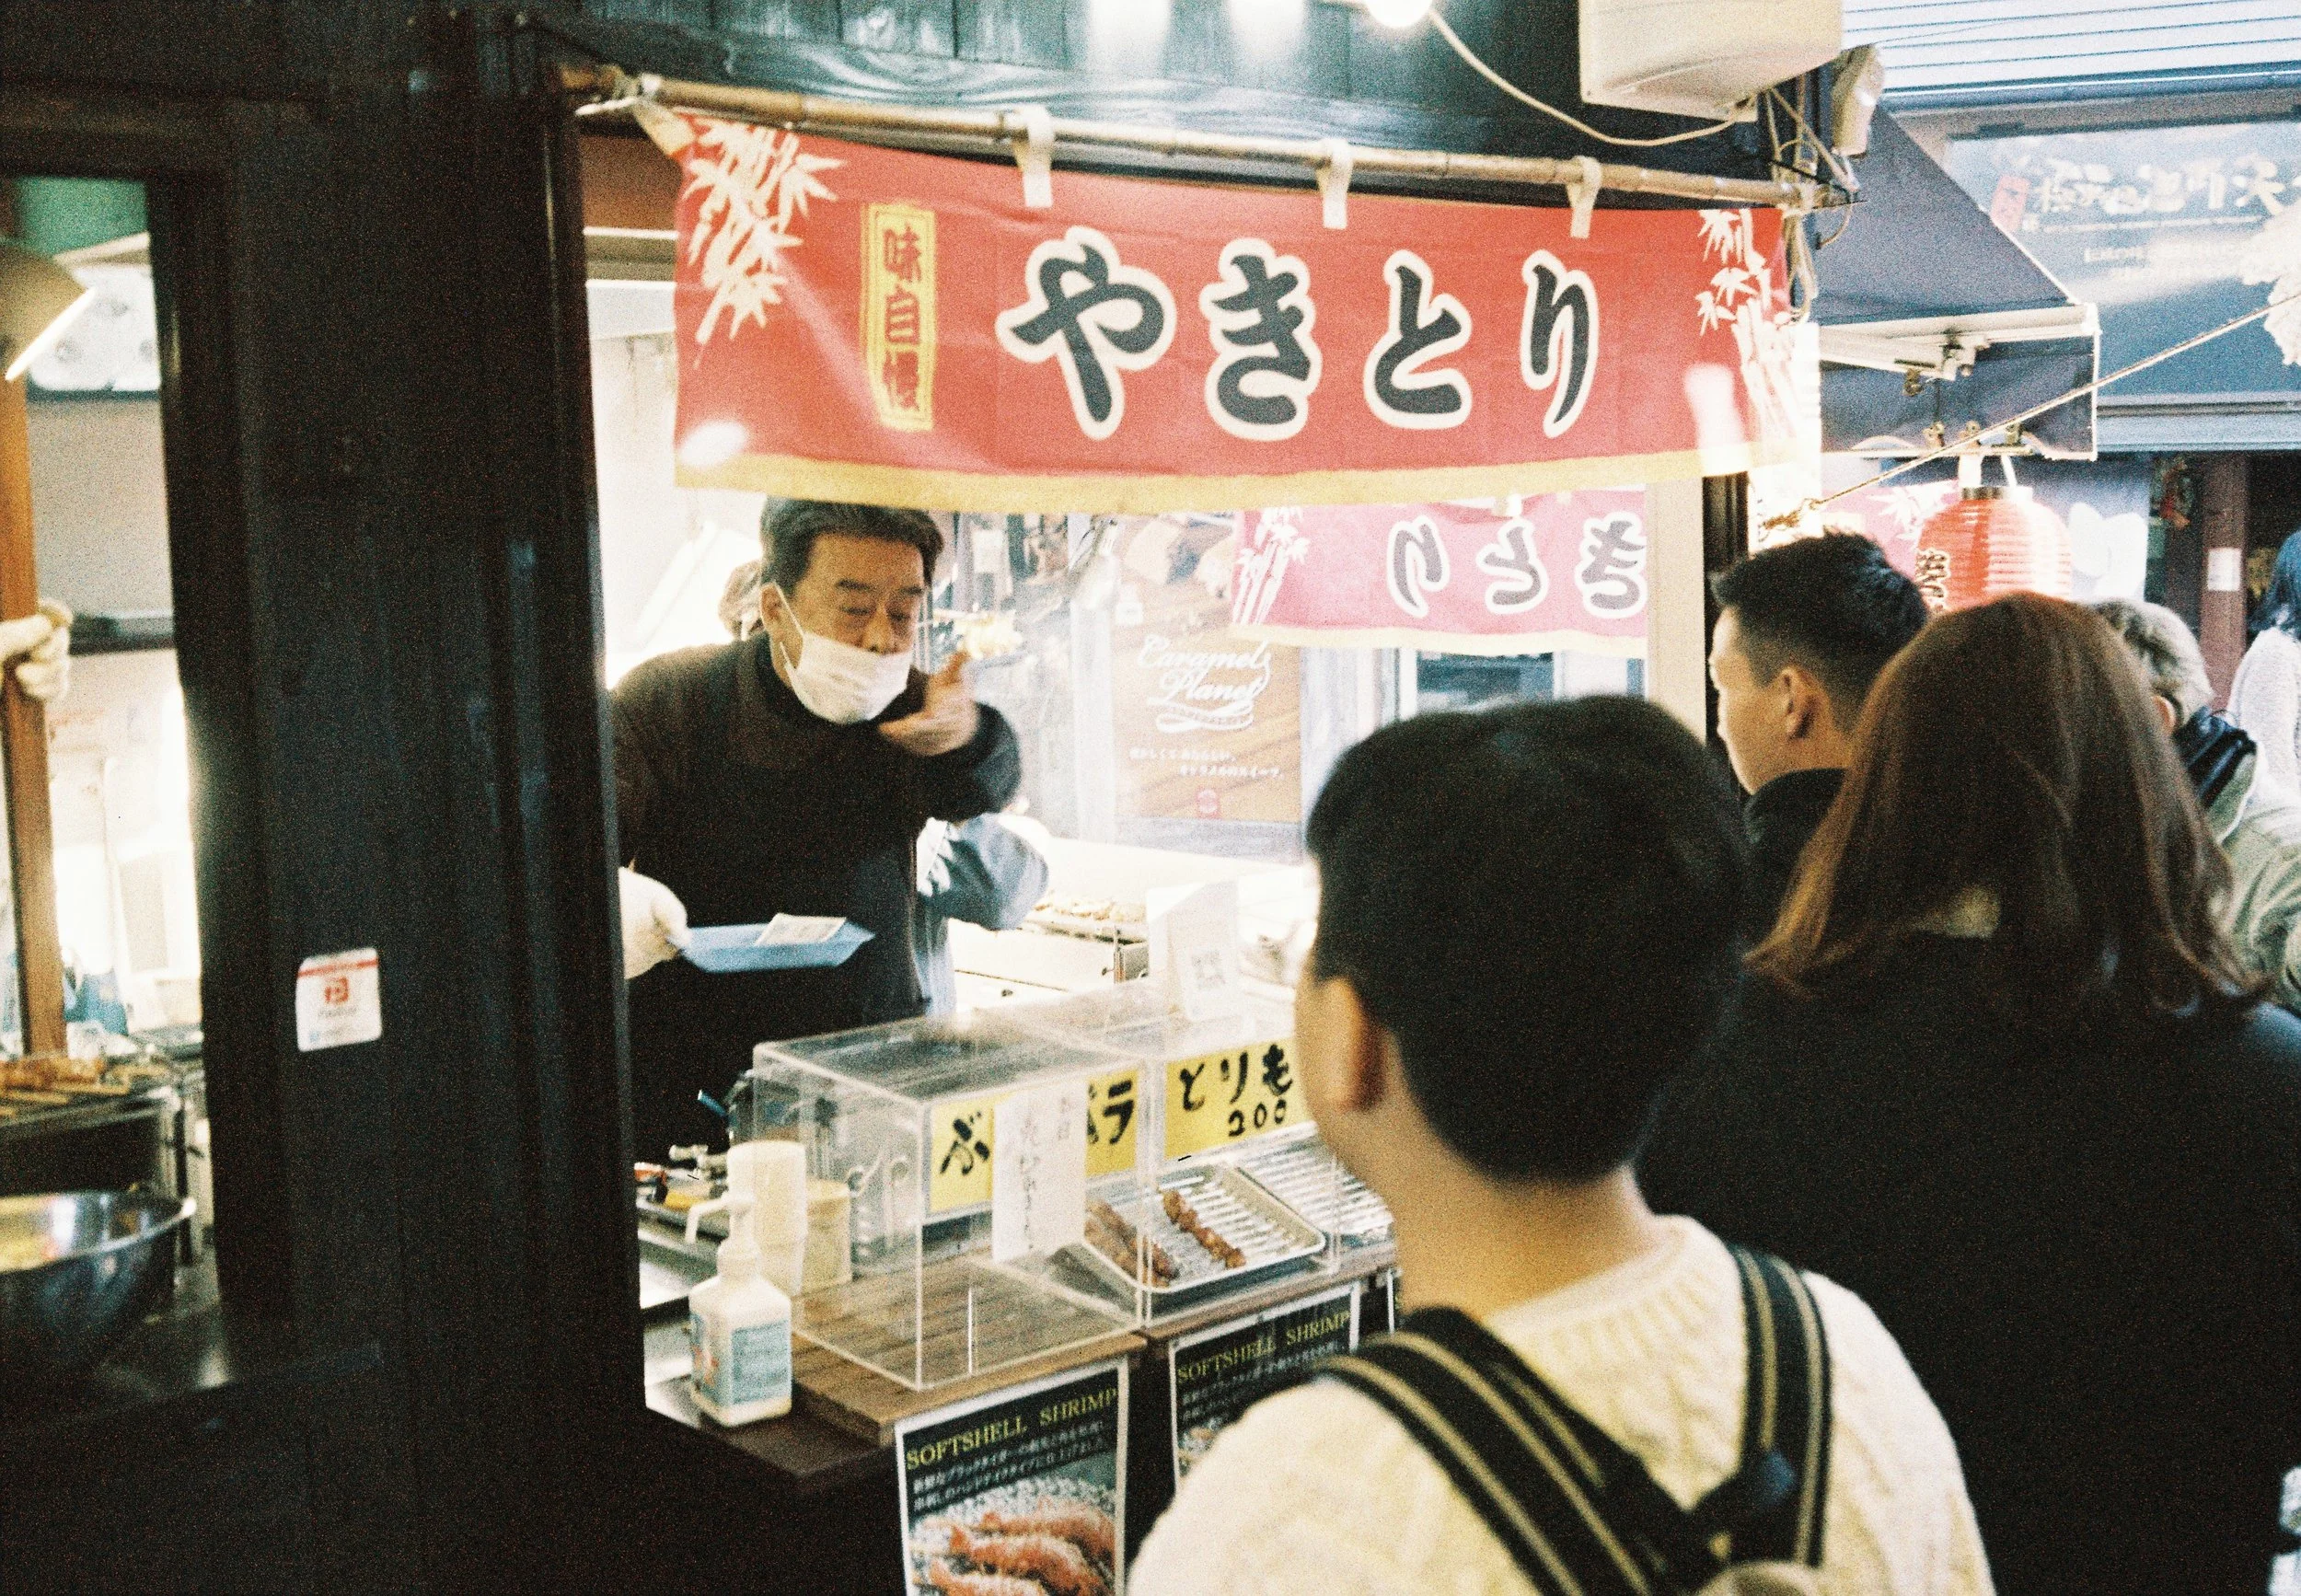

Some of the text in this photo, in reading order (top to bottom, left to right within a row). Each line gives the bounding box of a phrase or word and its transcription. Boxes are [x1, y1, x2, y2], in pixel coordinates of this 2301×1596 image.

[882, 224, 922, 412] 味自慢
[996, 226, 1598, 440] やきとり
[1137, 633, 1271, 672] Caramel
[1227, 1098, 1288, 1138] 200
[1176, 1335, 1278, 1385] SOFTSHELL
[1285, 1311, 1350, 1347] SHRIMP
[906, 1415, 1028, 1472] SOFTSHELL
[1038, 1388, 1118, 1428] SHRIMP
